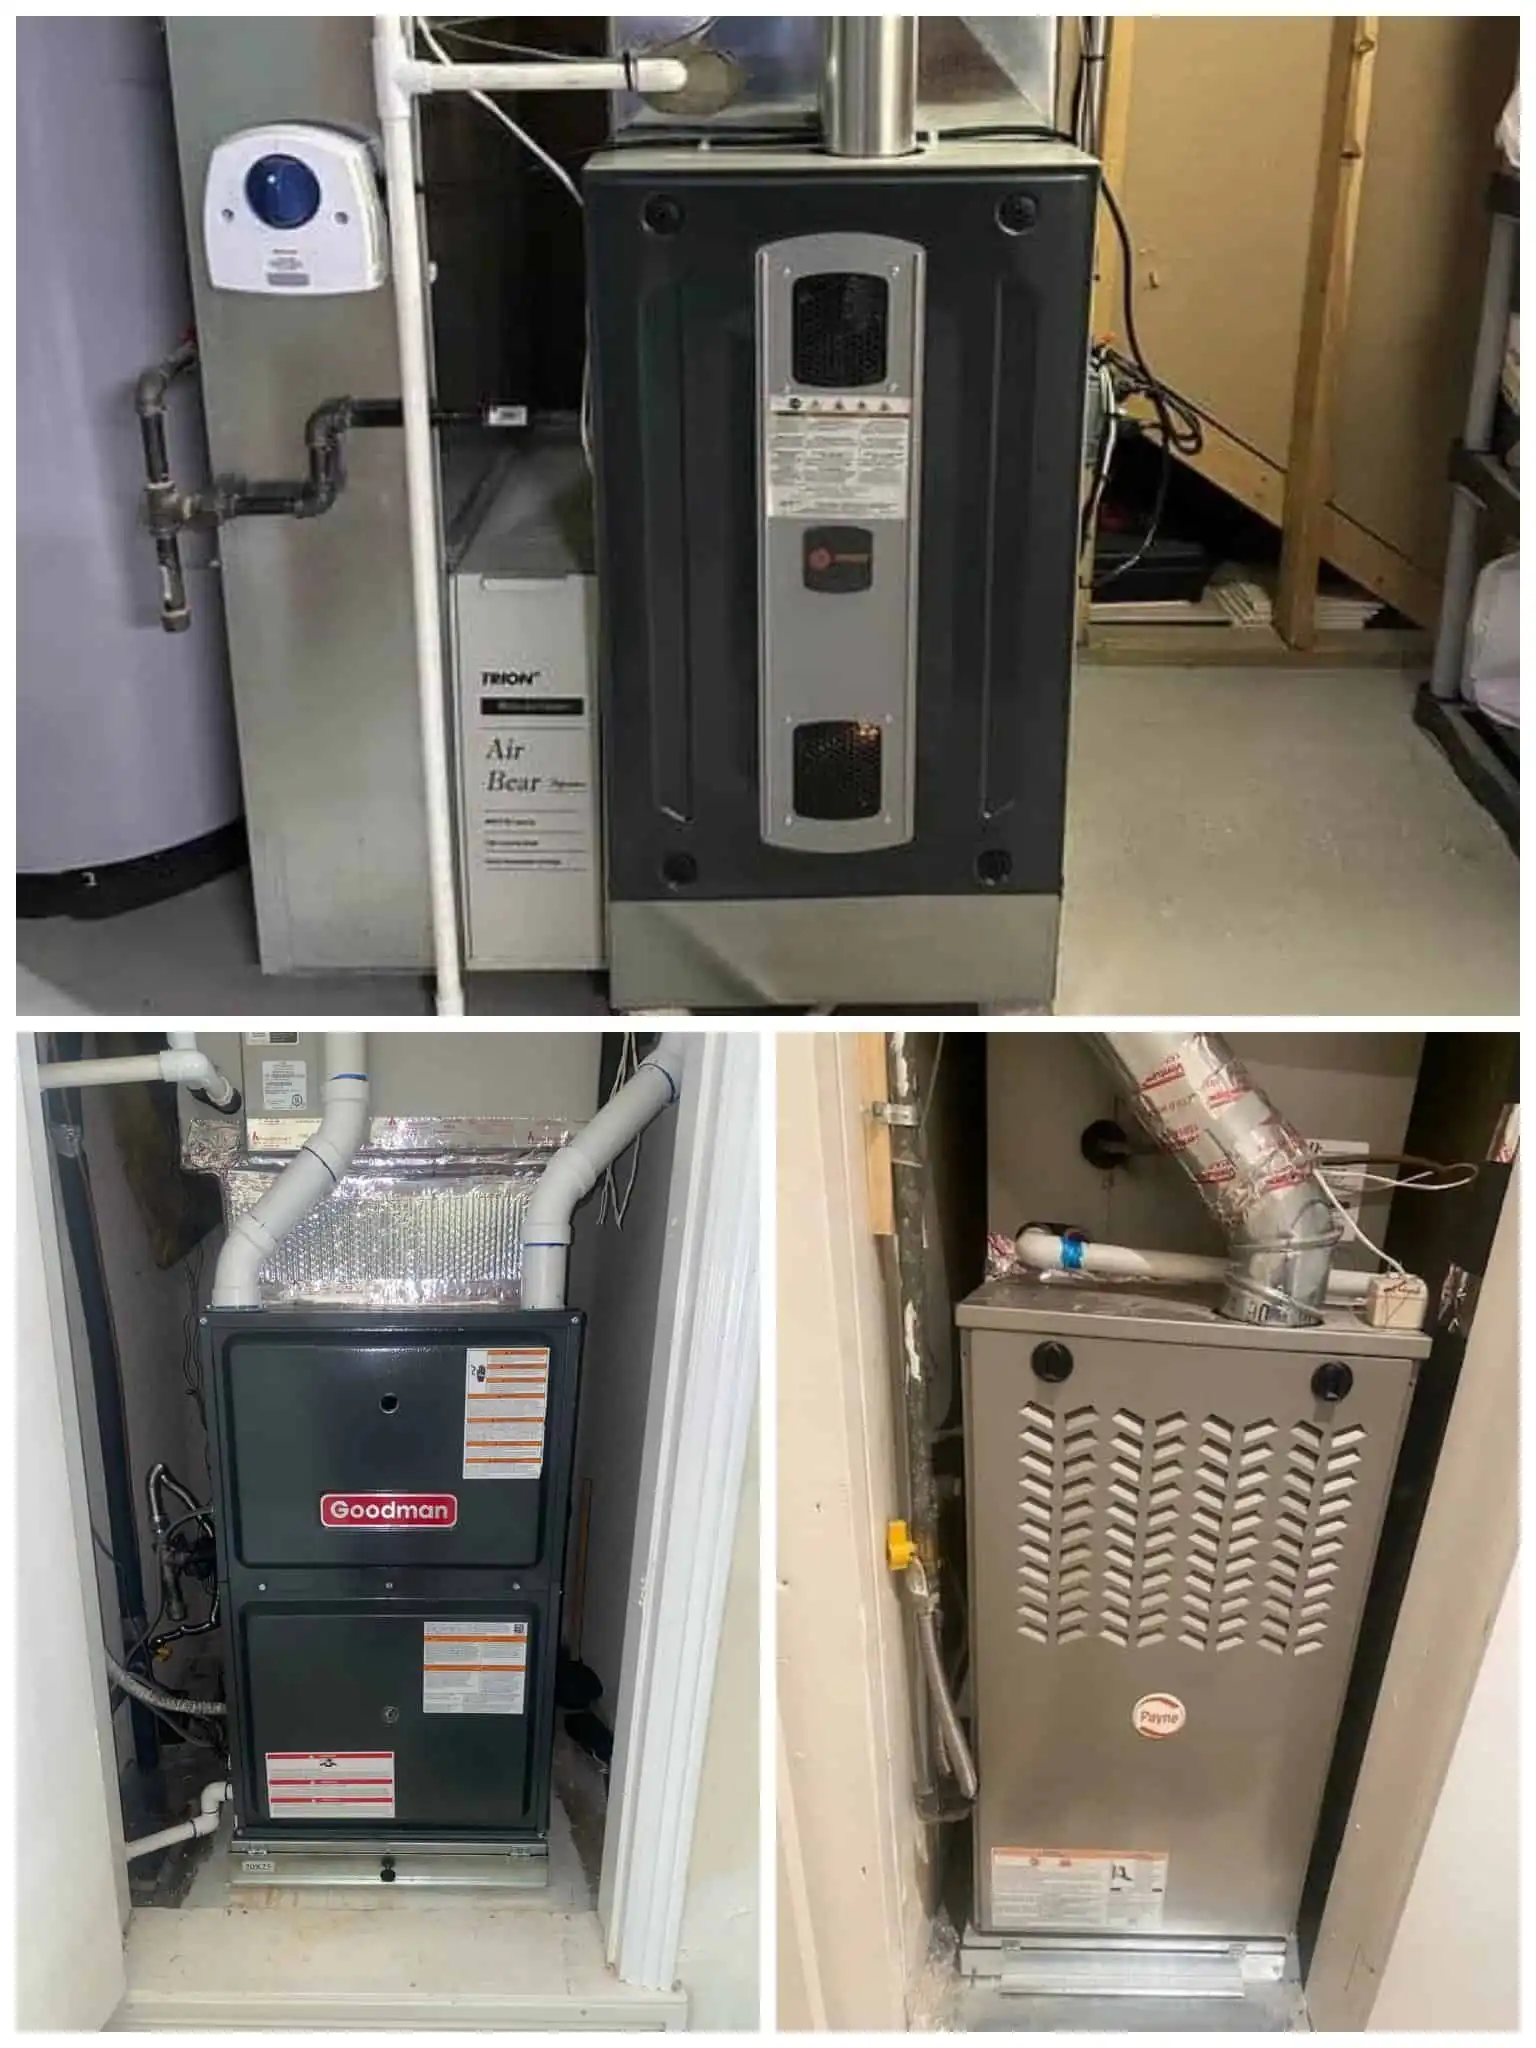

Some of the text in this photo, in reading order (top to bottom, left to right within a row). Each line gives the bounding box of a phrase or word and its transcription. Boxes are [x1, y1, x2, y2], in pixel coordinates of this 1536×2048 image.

[485, 738, 525, 760] Air
[486, 770, 542, 793] Bear
[330, 1500, 449, 1520] Goodman
[1140, 1711, 1180, 1727] Payne
